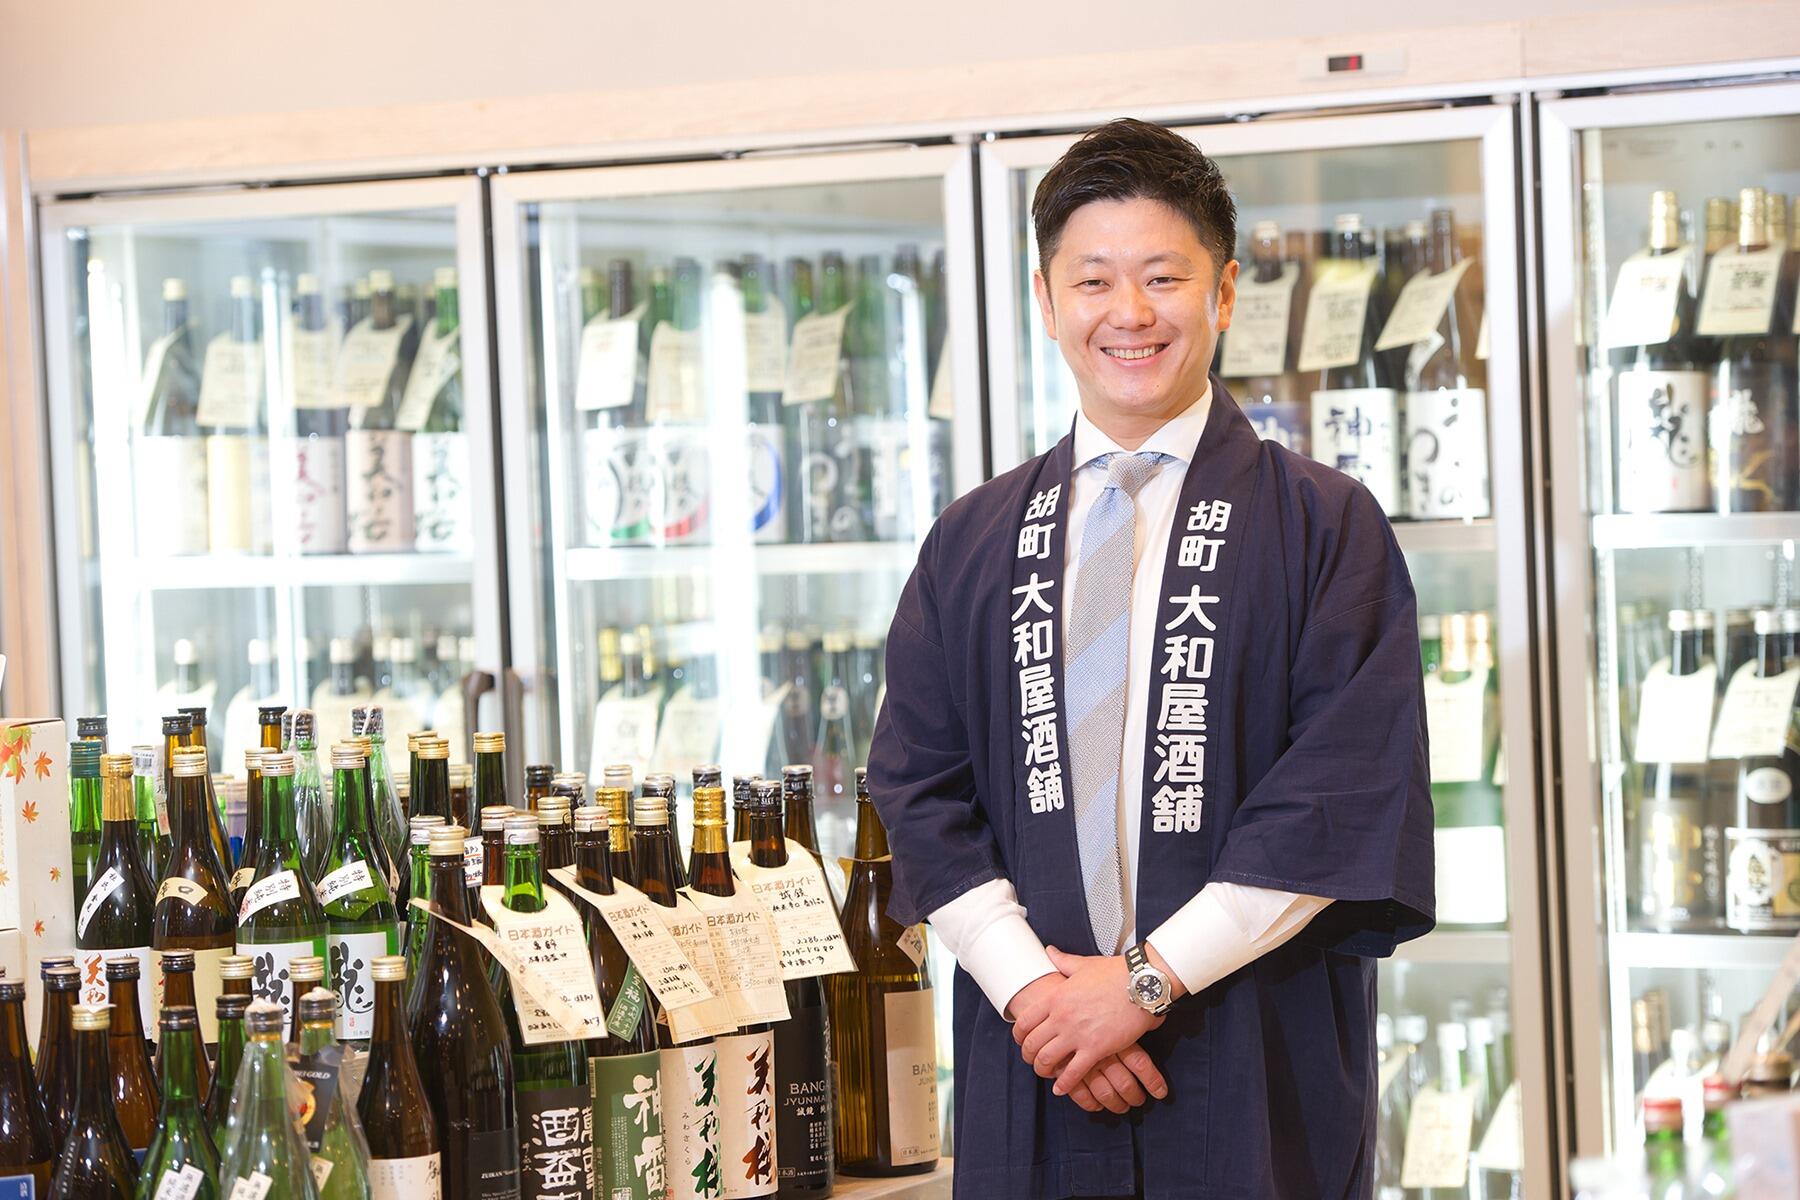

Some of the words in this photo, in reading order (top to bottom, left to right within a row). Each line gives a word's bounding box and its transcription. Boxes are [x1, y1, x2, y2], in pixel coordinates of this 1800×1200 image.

[1017, 483, 1062, 560] 胡町
[1177, 499, 1232, 572] 胡町
[1011, 572, 1066, 815] 大和屋酒舗
[1151, 584, 1221, 834] 大和屋酒舗
[752, 875, 816, 894] 日本酒ガイド
[508, 924, 576, 941] 日本酒ガイド
[606, 903, 650, 922] 日本酒ガイド
[707, 912, 760, 927] 日本酒ガイド
[681, 1111, 693, 1166] みわさくら
